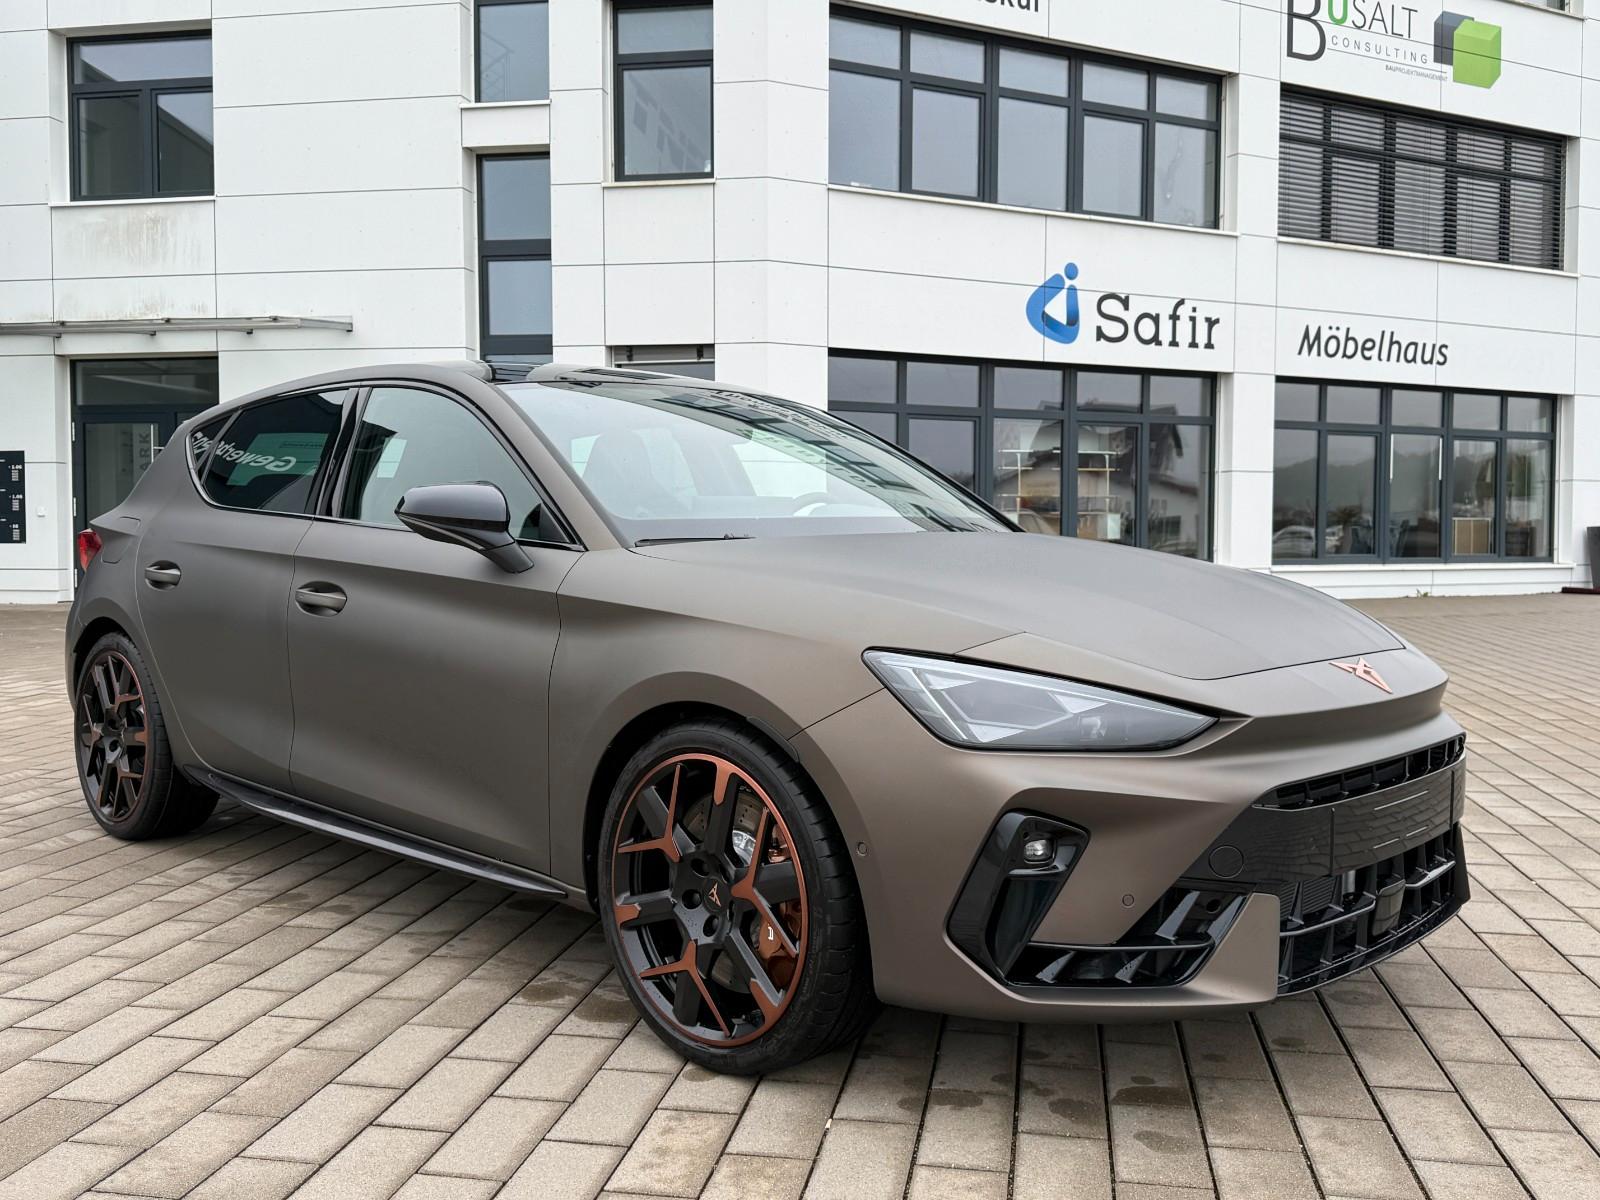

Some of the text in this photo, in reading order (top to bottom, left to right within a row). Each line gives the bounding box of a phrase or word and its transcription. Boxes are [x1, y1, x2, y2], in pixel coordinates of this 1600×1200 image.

[1331, 34, 1428, 65] CONSULTING
[1096, 292, 1220, 350] Safir
[1297, 324, 1449, 367] Möbelhaus
